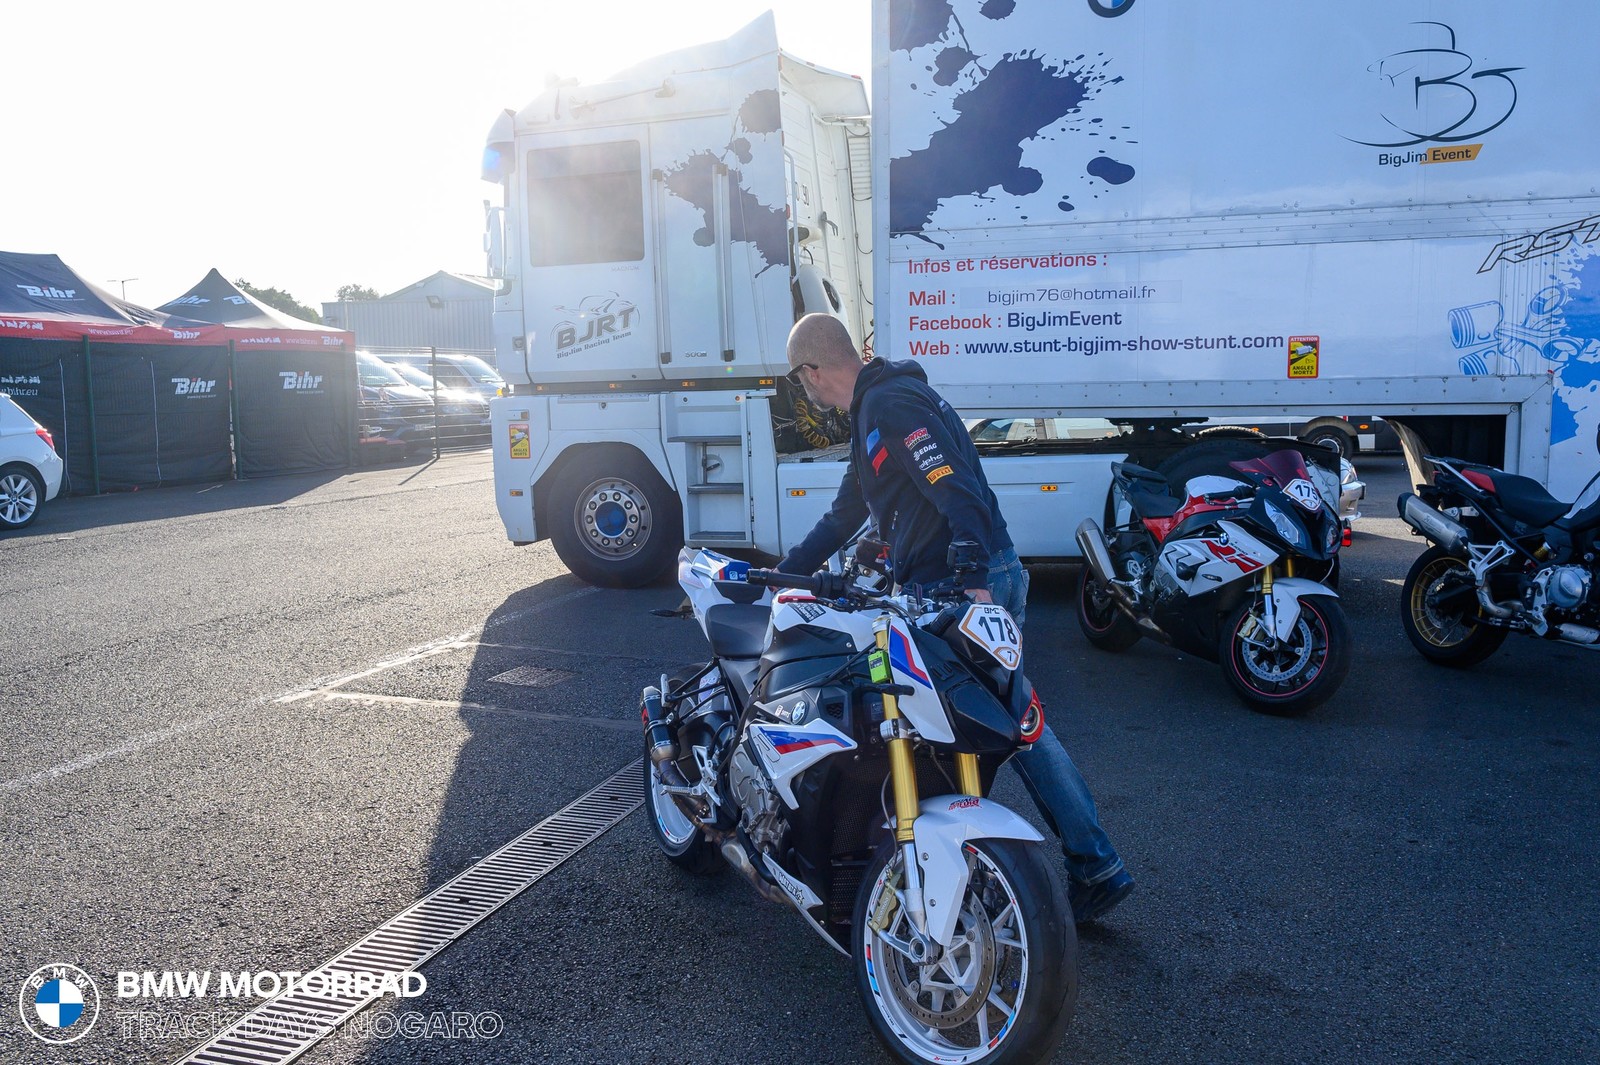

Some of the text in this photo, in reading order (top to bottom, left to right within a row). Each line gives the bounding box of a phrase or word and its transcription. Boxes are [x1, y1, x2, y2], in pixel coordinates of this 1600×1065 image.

[1378, 148, 1472, 168] BigJim Event
[908, 260, 951, 274] Infos
[956, 259, 975, 271] et
[980, 252, 1097, 271] réservations
[16, 284, 76, 298] Bihr
[909, 290, 946, 306] Mail
[988, 286, 1156, 306] bigjim76@hotmail.fr
[557, 306, 635, 350] BJRT
[909, 314, 992, 331] Facebook
[1007, 311, 1122, 331] BigJimEvent
[321, 335, 344, 346] Bihr
[584, 338, 611, 351] Racing
[909, 341, 950, 356] Web
[964, 335, 1284, 356] www.stunt-bigjim-show-stunt.com
[171, 377, 216, 395] Bihr
[279, 370, 323, 390] Bihr
[919, 442, 937, 454] EDAG
[919, 453, 943, 469] alpha
[978, 616, 1018, 645] 178
